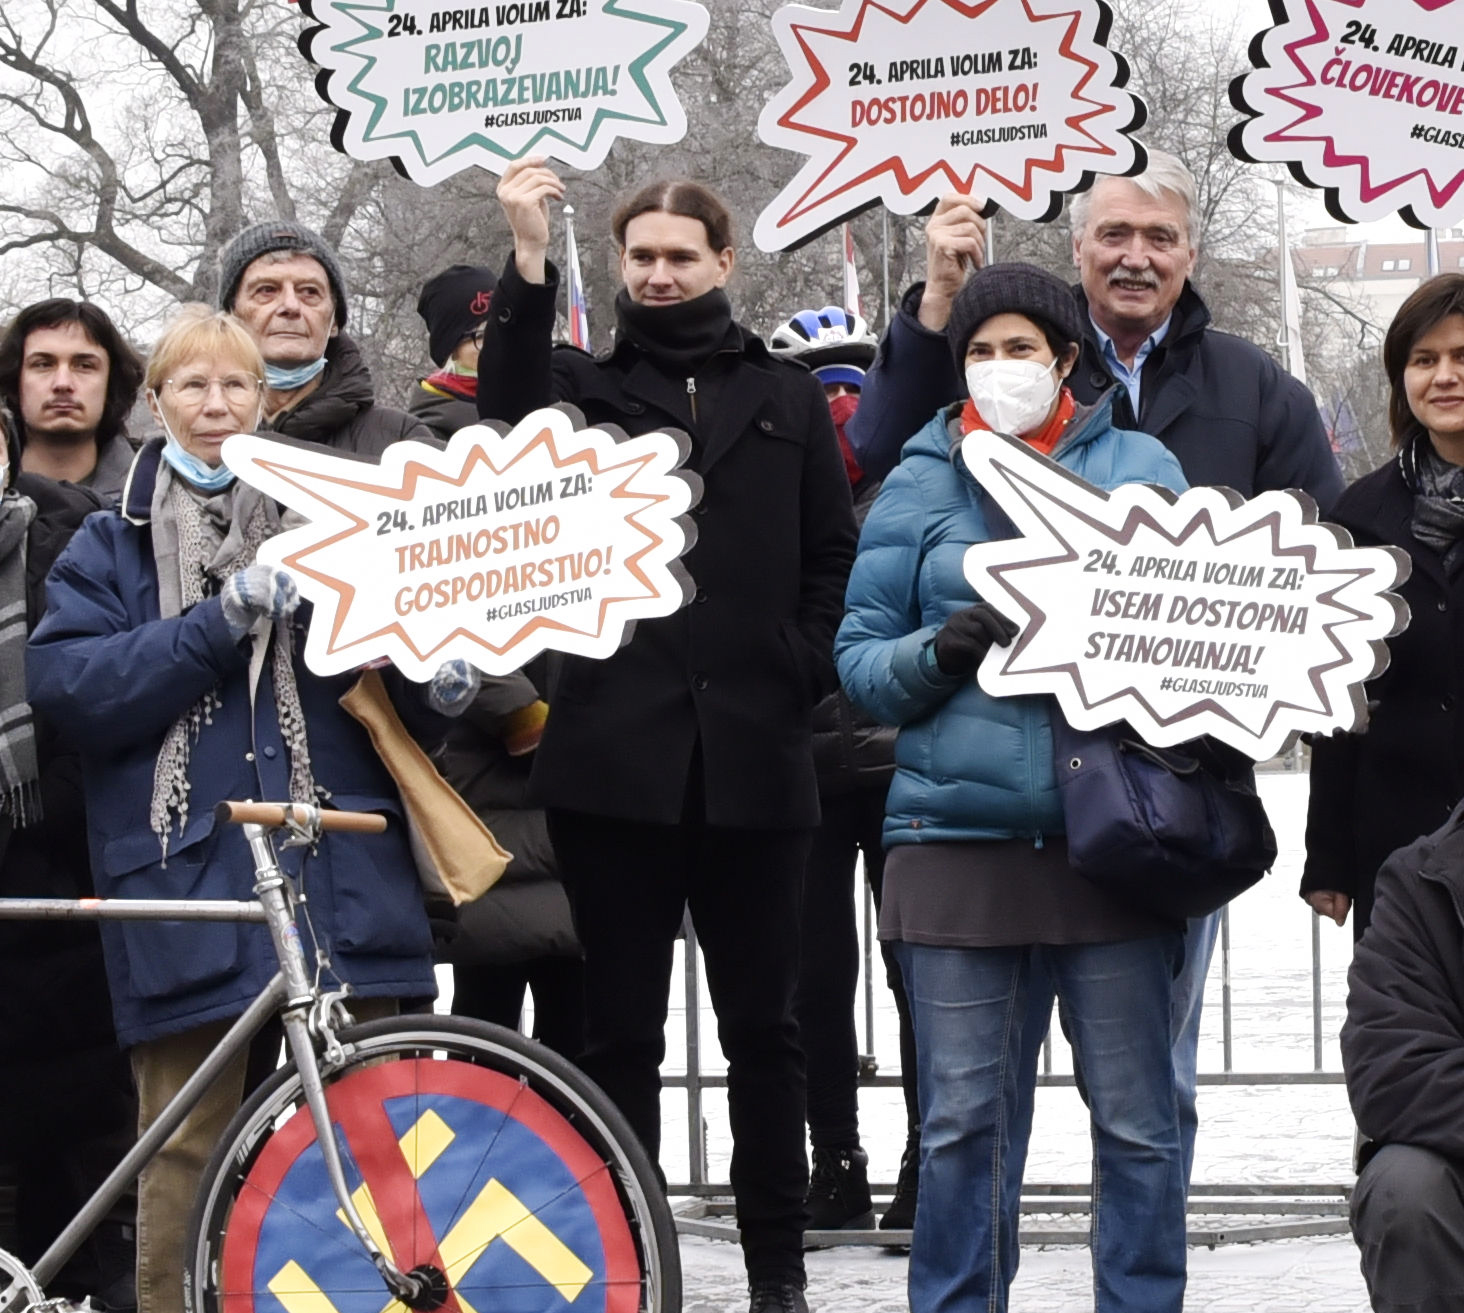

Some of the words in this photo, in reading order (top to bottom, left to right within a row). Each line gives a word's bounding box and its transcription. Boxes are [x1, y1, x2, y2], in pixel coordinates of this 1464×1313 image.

[388, 13, 423, 38] 24.
[429, 7, 490, 33] APRILA
[496, 0, 550, 26] VOLIM
[424, 33, 523, 75] RAZVOJ
[1340, 20, 1379, 52] 24.
[1386, 34, 1458, 68] APRILA
[849, 62, 882, 87] 24.
[888, 57, 945, 83] APRILA
[950, 51, 1002, 77] VOLIM
[1008, 47, 1037, 71] ZA:
[403, 64, 621, 117] IZOBRAŽEVANJA!
[851, 89, 968, 128] DOSTOJNO
[976, 82, 1039, 116] DELO!
[484, 107, 581, 128] #GLASLJUDSTVA
[950, 123, 1047, 147] #GLASLJUDSTVA
[377, 509, 415, 536] 24.
[422, 495, 488, 527] APRILA
[494, 480, 553, 512] VOLIM
[560, 473, 592, 499] ZA:
[395, 515, 560, 574] TRAJNOSTNO
[395, 545, 613, 617] GOSPODARSTVO!
[1083, 549, 1121, 576] 24.
[1128, 556, 1197, 582] APRILA
[1203, 562, 1265, 588] VOLIM
[1268, 568, 1305, 590] ZA:
[486, 587, 592, 622] #GLASLJUDSTVA
[1090, 588, 1164, 621] VSEM
[1166, 596, 1309, 635] DOSTOPNA
[1084, 631, 1266, 675] STANOVANJA!
[1160, 677, 1268, 699] #GLASLJUDSTVA
